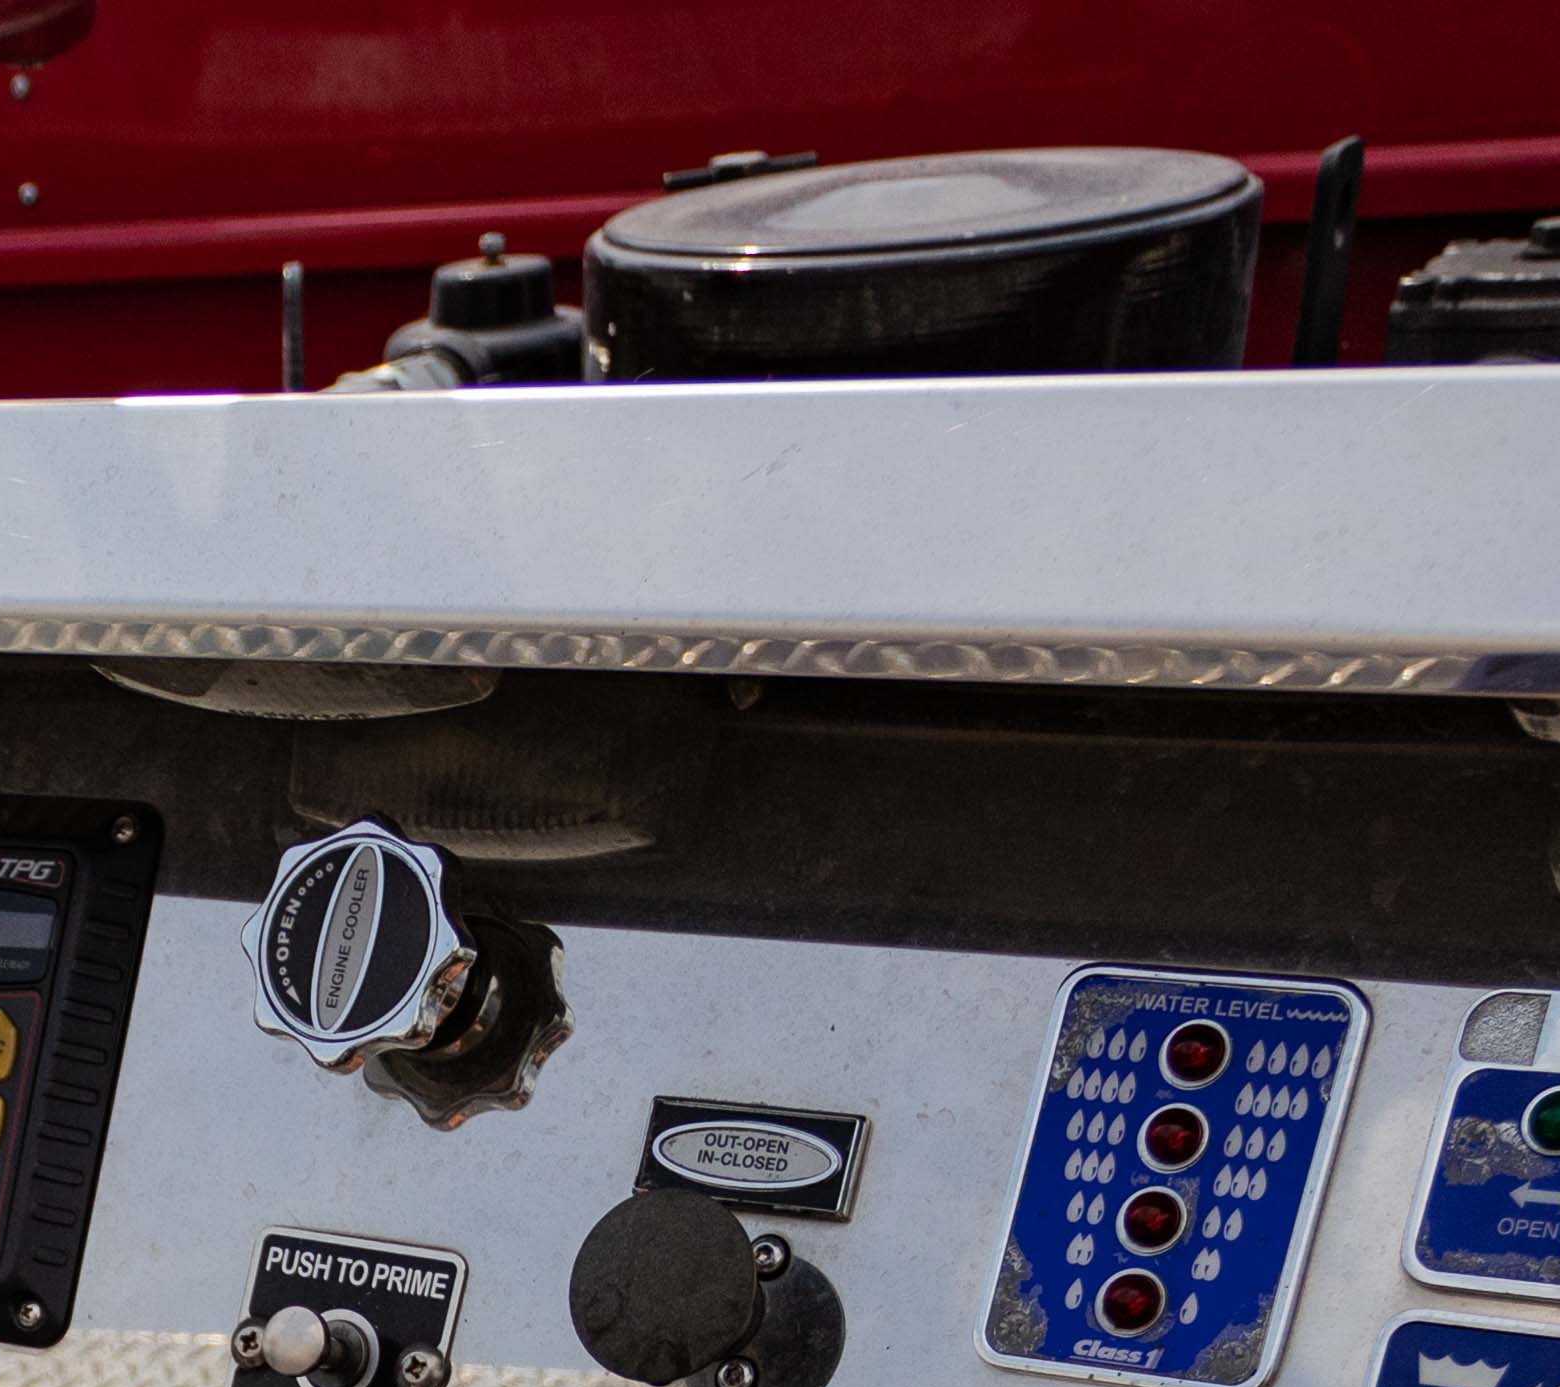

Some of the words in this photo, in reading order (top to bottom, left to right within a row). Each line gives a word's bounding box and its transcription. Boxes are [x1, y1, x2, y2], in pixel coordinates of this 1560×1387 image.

[276, 897, 302, 962] OPEN
[326, 944, 351, 1009] ENGINE
[343, 868, 370, 941] COOLER
[1134, 992, 1209, 1016] WATER
[1215, 999, 1283, 1021] LEVEL
[703, 1133, 790, 1155] OUT-OPEN
[696, 1150, 789, 1173] IN-CLOSED
[1497, 1217, 1560, 1241] OPEN
[266, 1246, 332, 1281] PUSH
[337, 1257, 369, 1287] TO
[371, 1263, 449, 1299] PRIME
